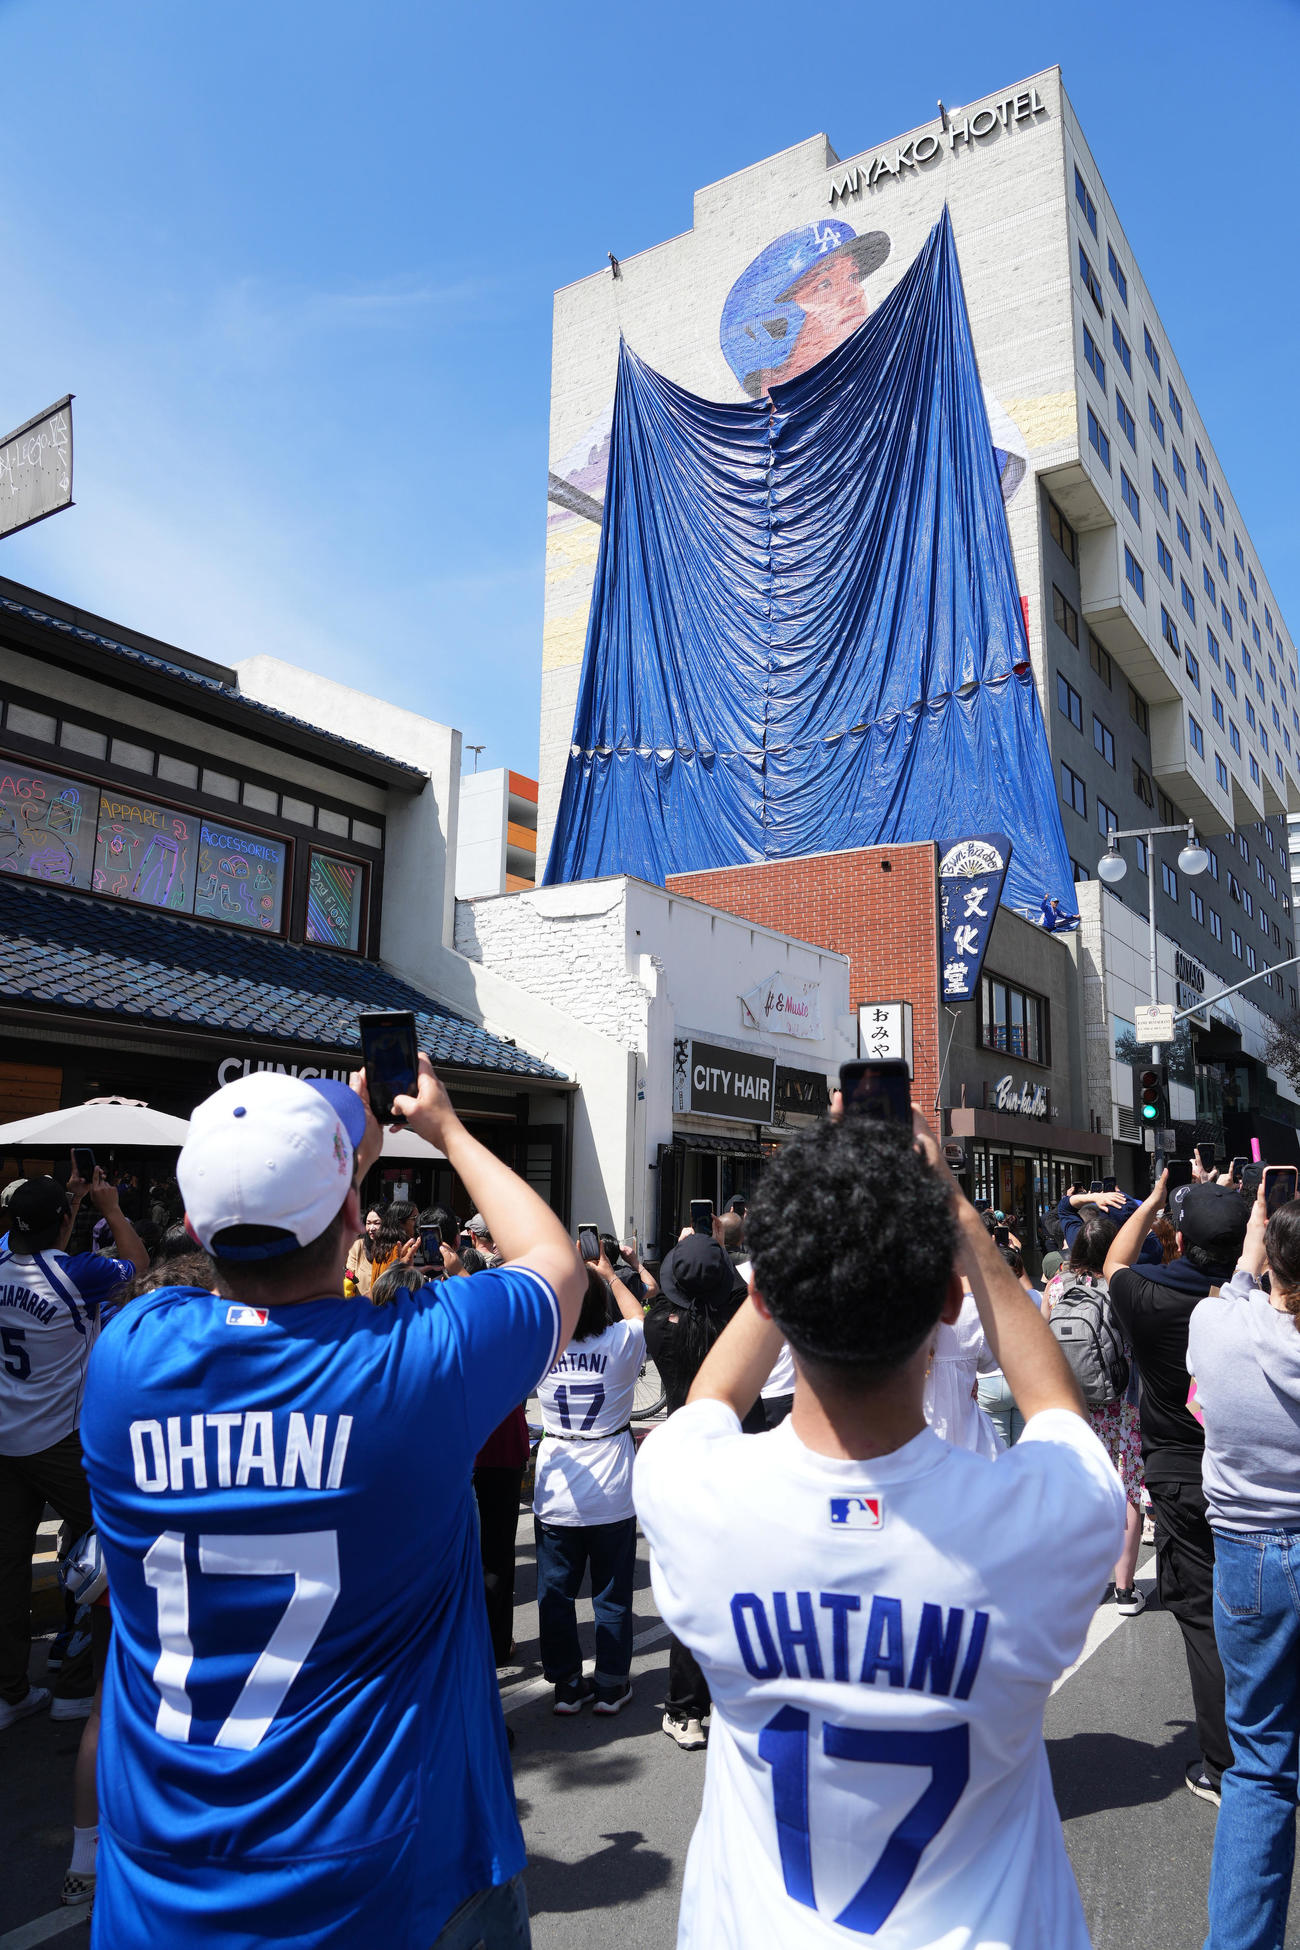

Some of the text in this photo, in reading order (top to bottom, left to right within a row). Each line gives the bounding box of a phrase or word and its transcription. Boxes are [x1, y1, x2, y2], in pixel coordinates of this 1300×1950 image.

[829, 88, 1045, 203] MIYAKO HOTEL
[808, 223, 842, 253] LA
[0, 776, 46, 800] AGS
[99, 797, 169, 830] APPAREL
[200, 827, 280, 864] ACCESSORIES
[310, 873, 348, 929] 2nd Floor
[944, 886, 989, 994] 文化堂
[776, 992, 785, 1012] &
[785, 995, 809, 1017] Music
[694, 1065, 731, 1095] CITY
[734, 1073, 770, 1102] HAIR
[1, 1326, 32, 1380] 5
[554, 1383, 606, 1431] 17
[129, 1411, 353, 1493] OHTANI
[142, 1529, 341, 1751] 17
[730, 1591, 991, 1701] OHTANI
[758, 1704, 971, 1936] 17
